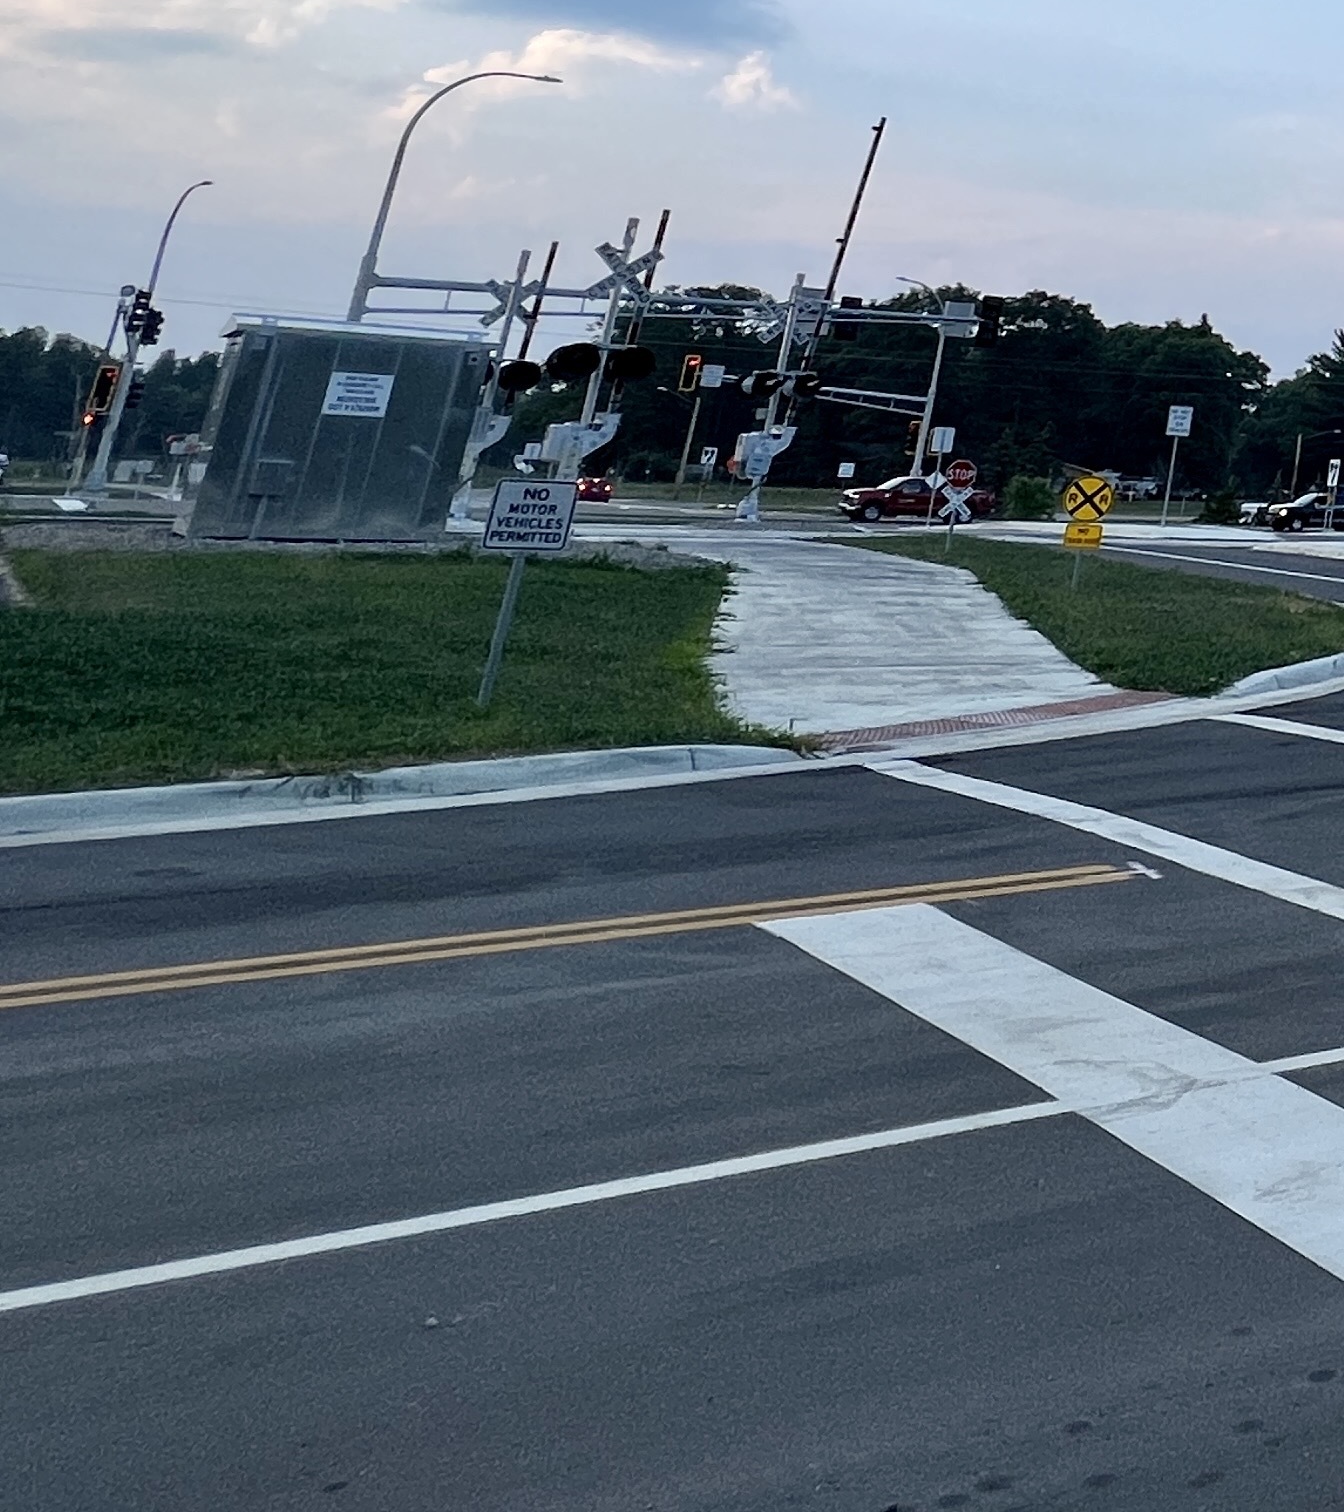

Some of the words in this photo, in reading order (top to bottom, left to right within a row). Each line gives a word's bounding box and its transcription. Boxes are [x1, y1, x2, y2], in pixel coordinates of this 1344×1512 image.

[947, 468, 975, 481] STOP
[522, 487, 550, 502] NO
[1068, 492, 1079, 504] R
[1098, 493, 1110, 506] R
[507, 503, 558, 516] MOTOR
[496, 516, 564, 530] VEHICLES
[488, 530, 562, 544] PERMITTED
